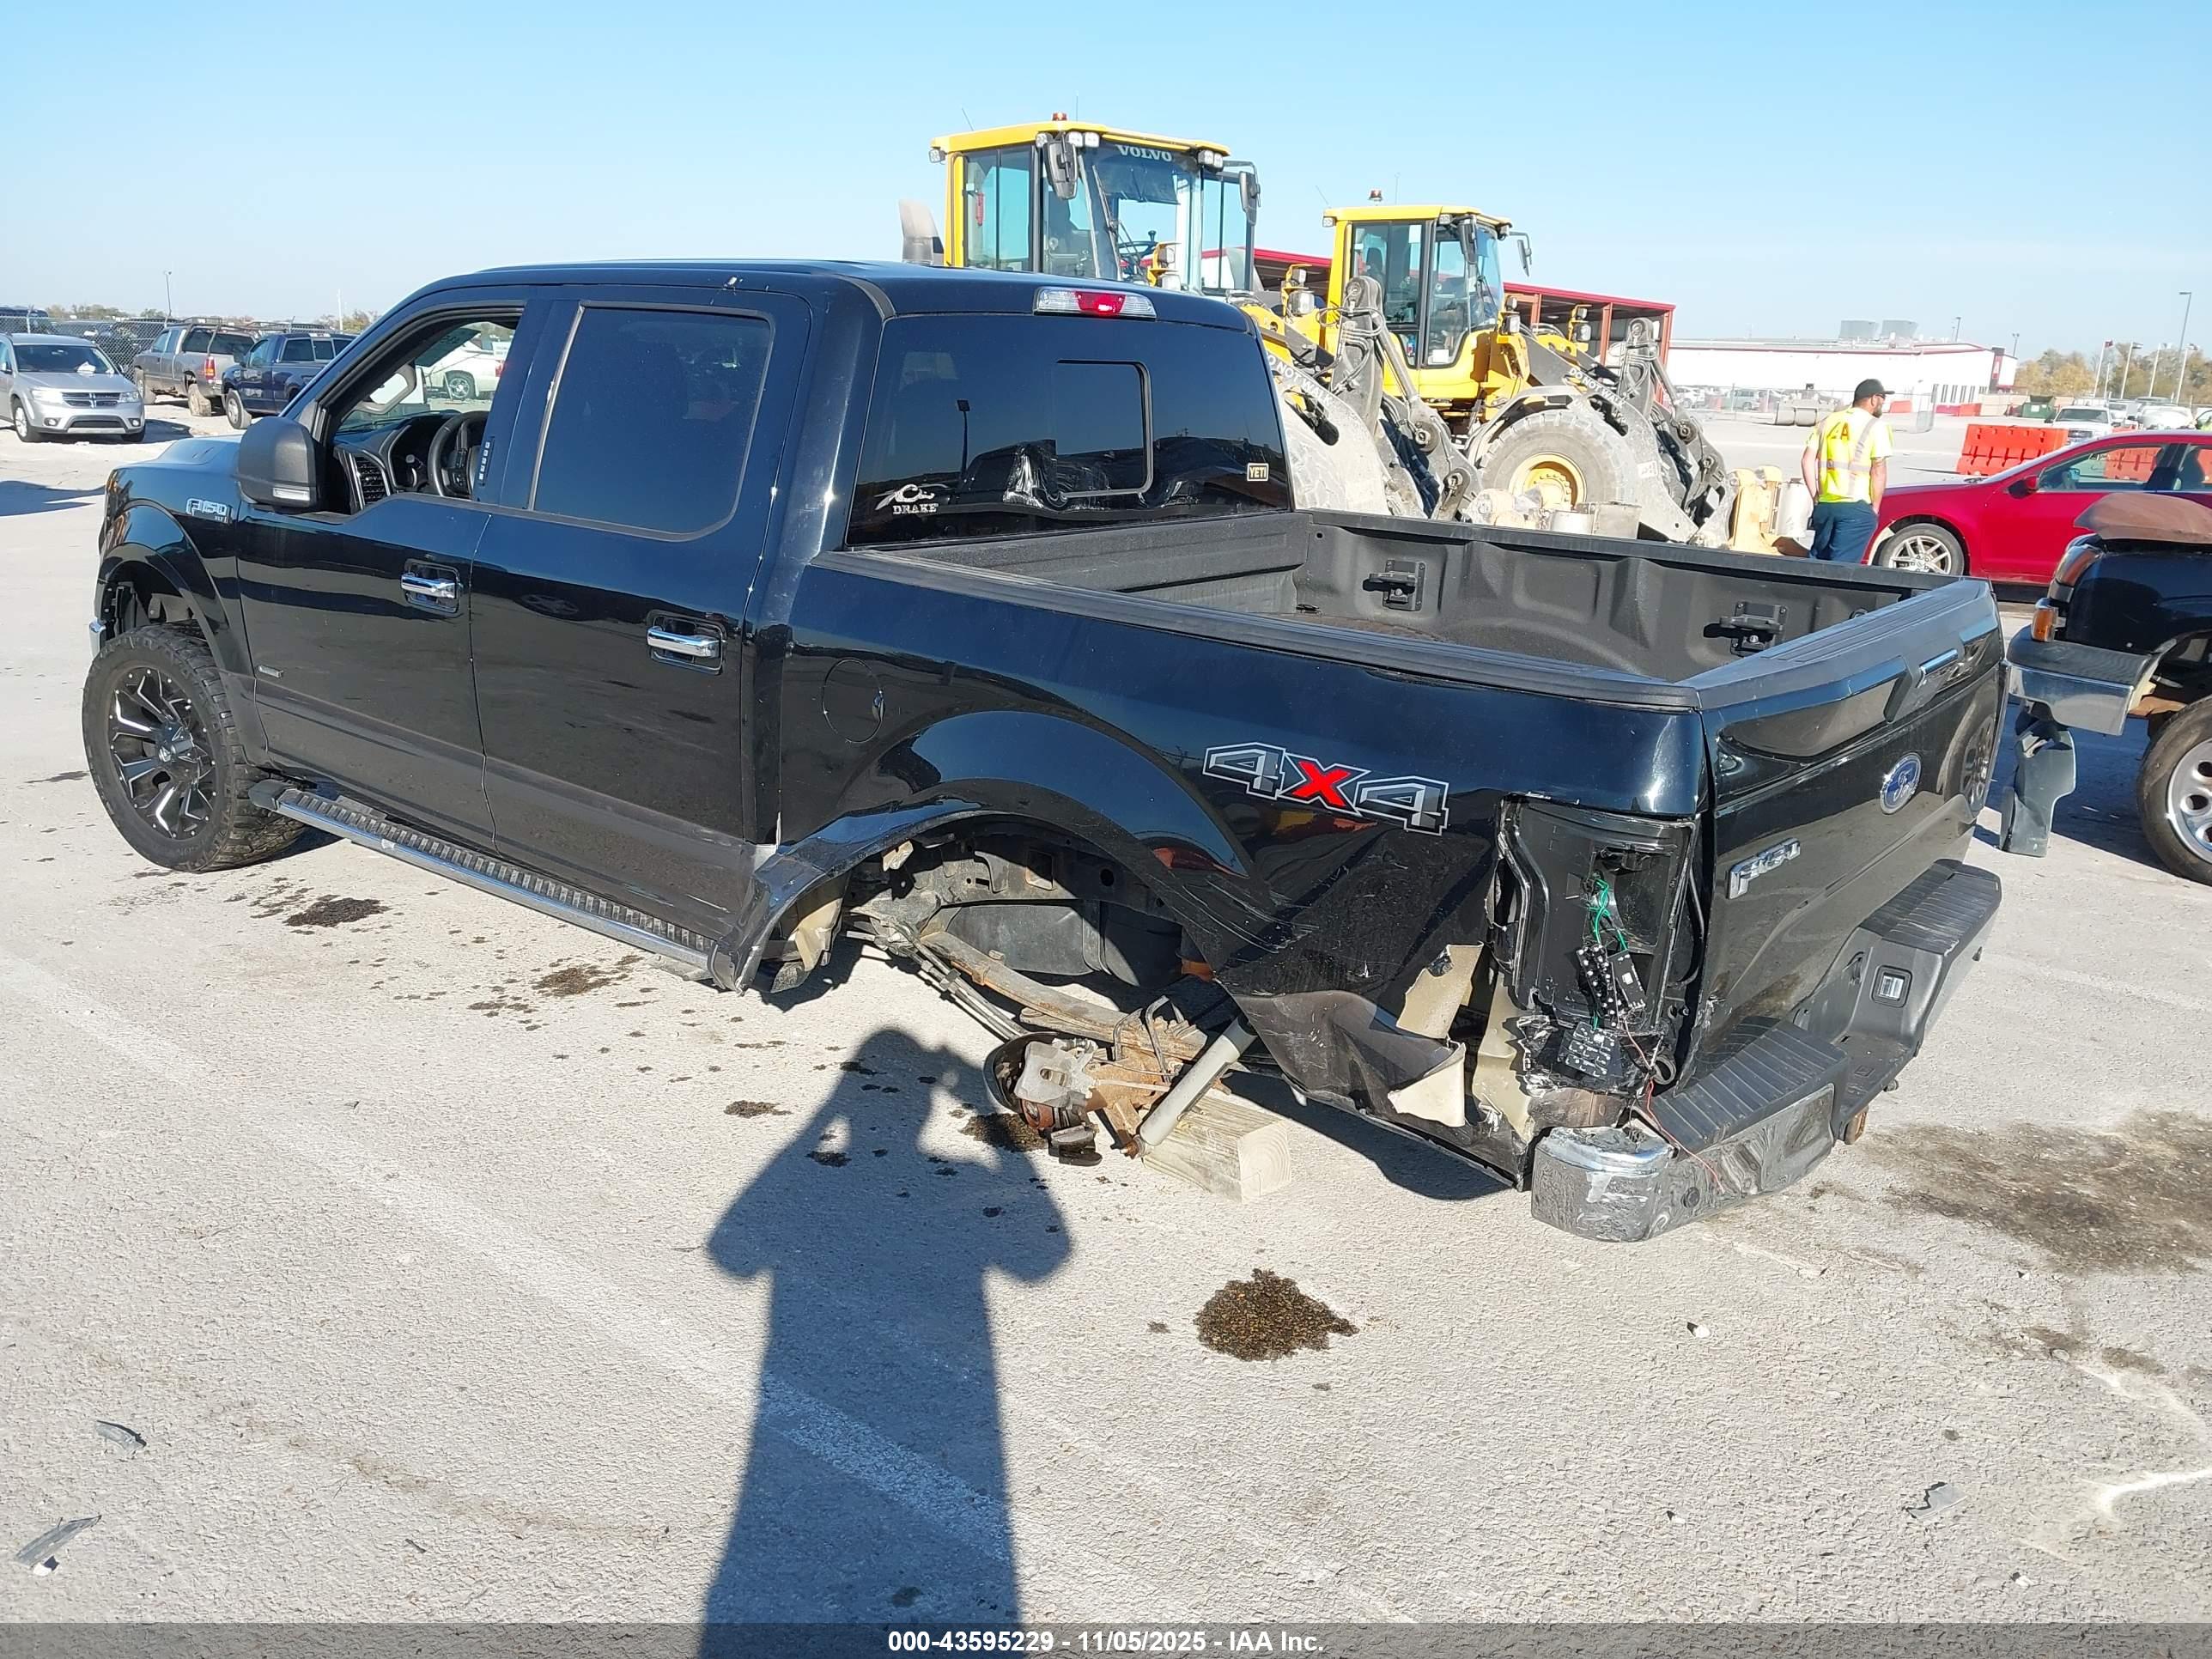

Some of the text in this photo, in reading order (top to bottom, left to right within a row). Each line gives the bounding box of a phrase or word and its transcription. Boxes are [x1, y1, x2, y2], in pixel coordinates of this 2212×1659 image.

[1115, 144, 1173, 162] VOLVO
[1276, 362, 1302, 382] NOT
[1302, 379, 1334, 407] WALK
[1569, 368, 1583, 380] DO
[1583, 378, 1604, 392] NOT
[1601, 386, 1626, 410] WALK
[1249, 466, 1267, 478] YETI
[893, 503, 938, 514] DRAKE
